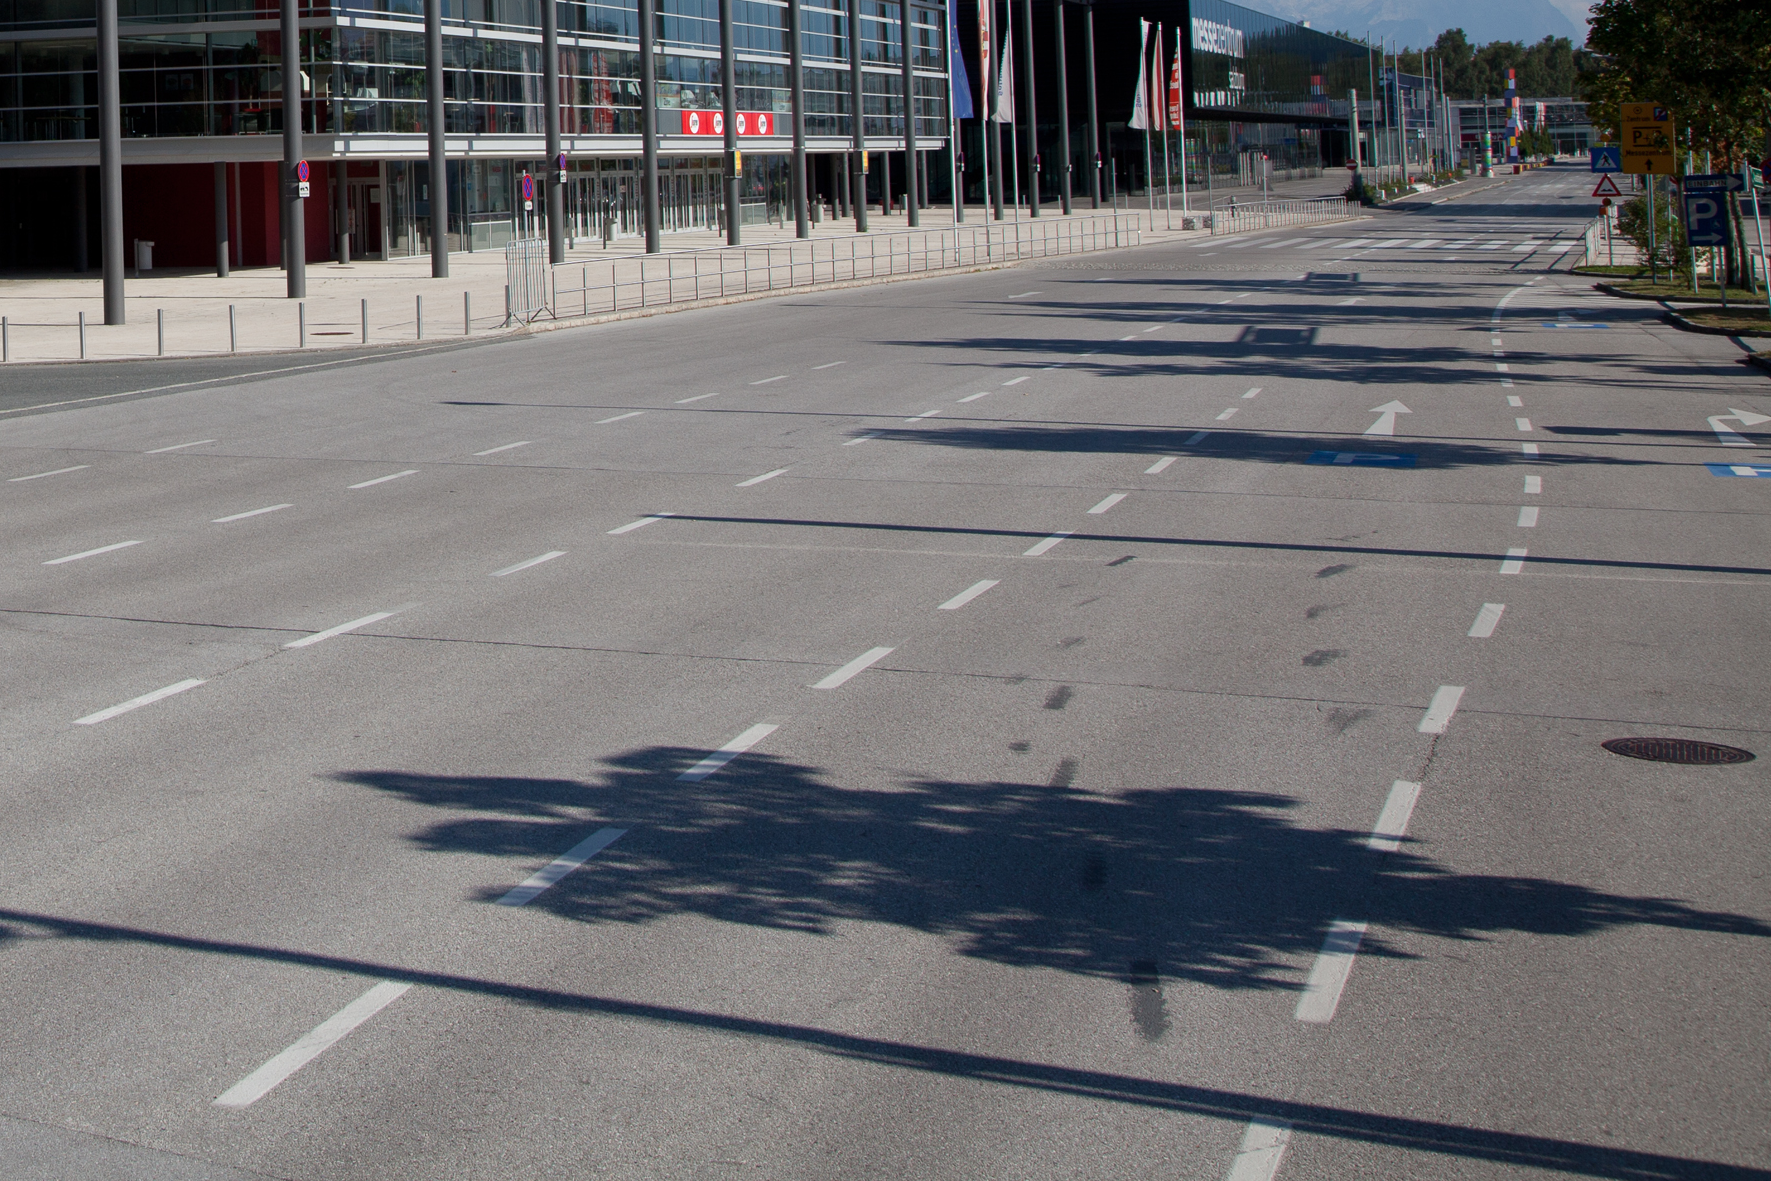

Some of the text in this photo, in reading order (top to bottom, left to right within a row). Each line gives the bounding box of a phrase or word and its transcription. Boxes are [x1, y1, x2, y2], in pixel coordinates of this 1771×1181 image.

[1191, 17, 1244, 59] messezentrum
[1688, 180, 1727, 188] EINBAHN
[1688, 197, 1718, 231] P
